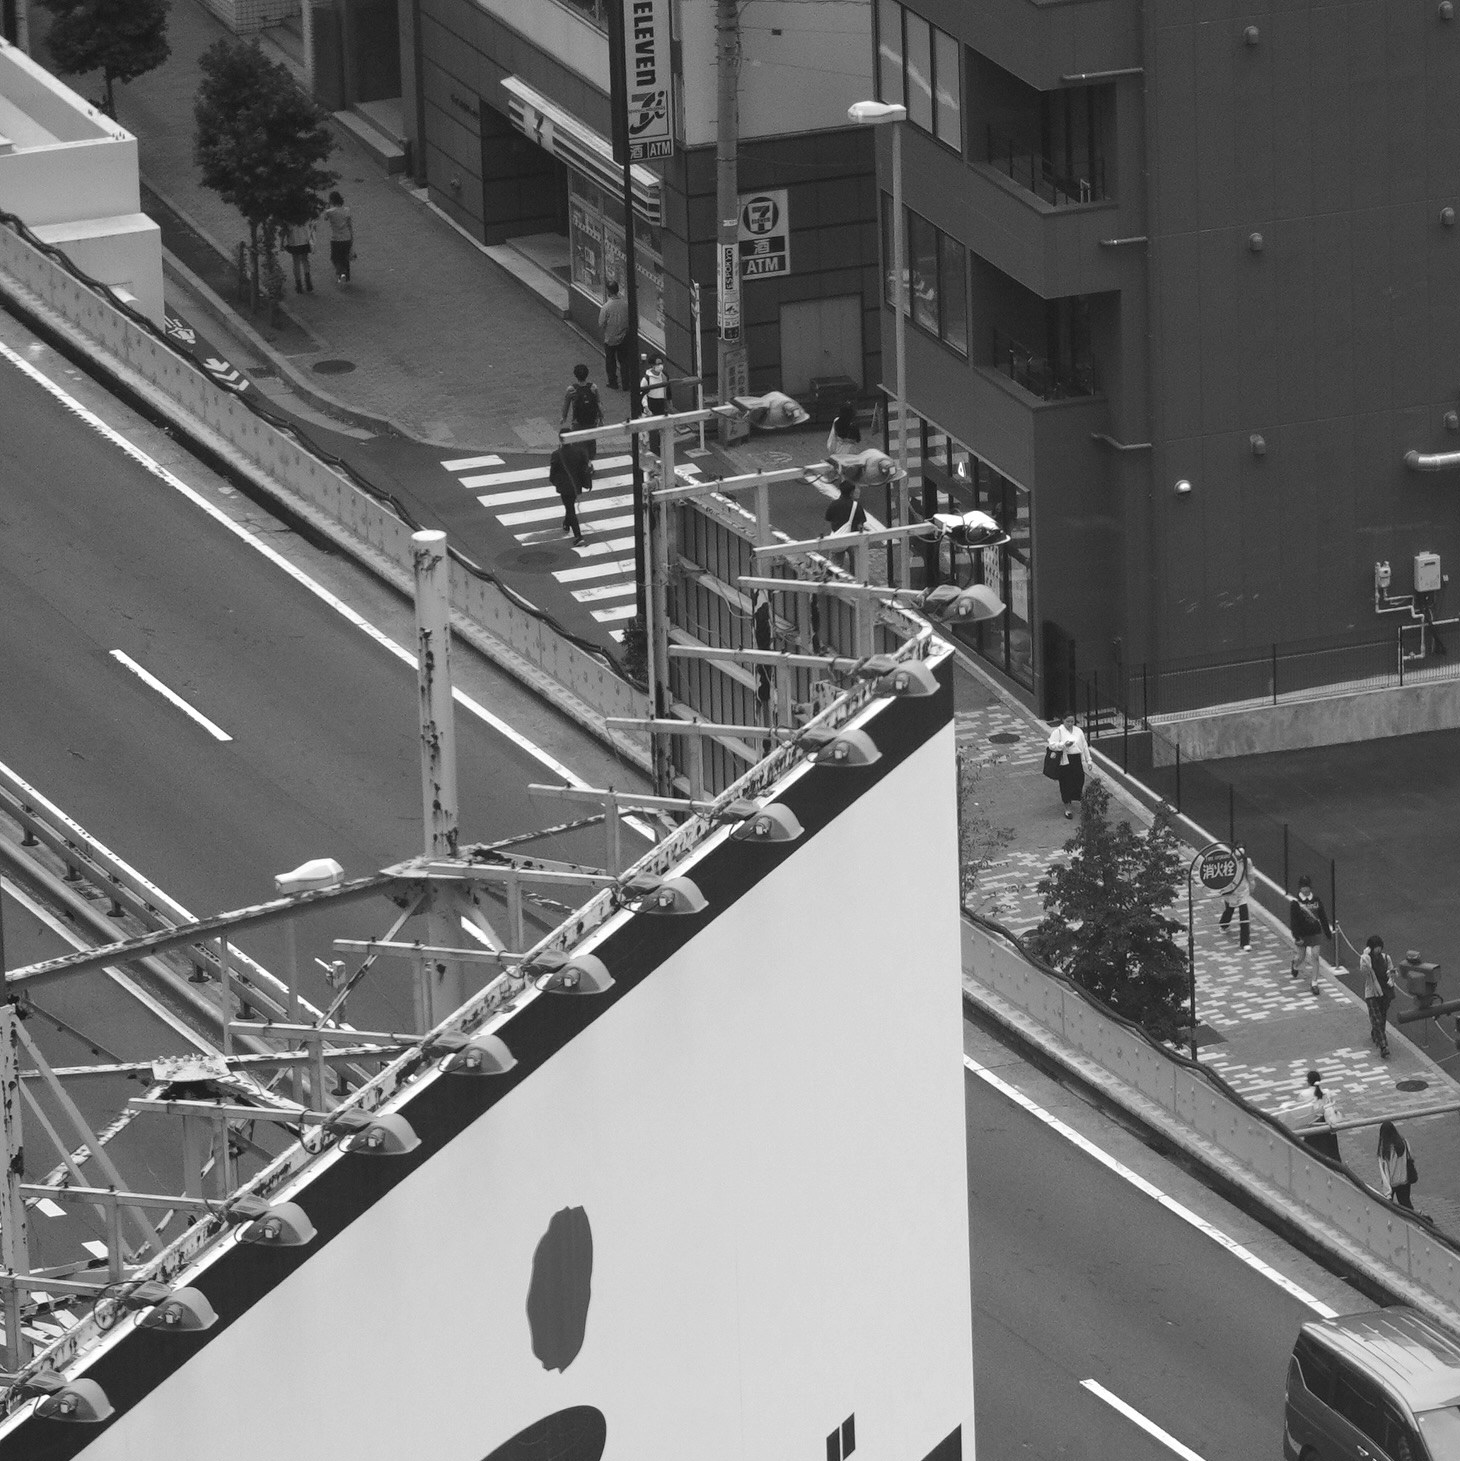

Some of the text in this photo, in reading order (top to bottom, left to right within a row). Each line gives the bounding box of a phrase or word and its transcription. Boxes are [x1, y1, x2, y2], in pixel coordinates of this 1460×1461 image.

[650, 141, 671, 158] ATM
[754, 238, 770, 255] 酒
[747, 256, 779, 274] ATM
[1203, 860, 1235, 880] 消火栓
